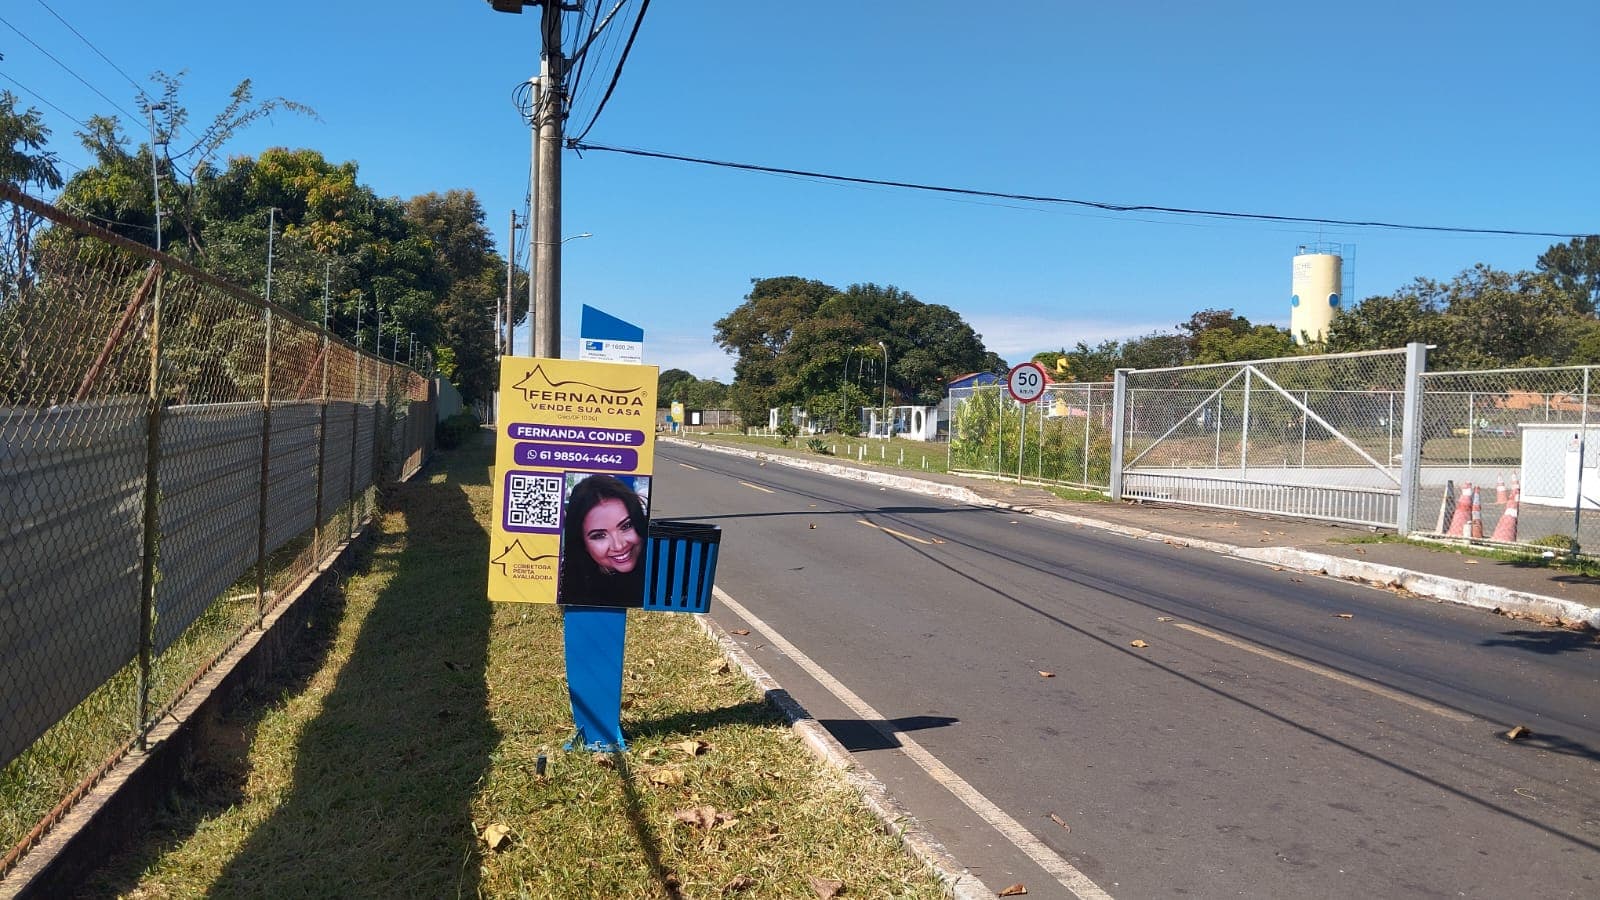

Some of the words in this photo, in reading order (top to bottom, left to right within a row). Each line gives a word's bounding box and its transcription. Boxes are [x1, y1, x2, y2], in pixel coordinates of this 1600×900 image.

[1018, 372, 1038, 387] 50
[529, 390, 643, 406] FERNANDA
[530, 403, 573, 412] VENDE
[607, 408, 641, 416] CASA
[517, 426, 586, 440] FERNANDA
[588, 430, 633, 443] CONDE
[540, 450, 551, 460] 61
[554, 451, 622, 464] 98504-4642
